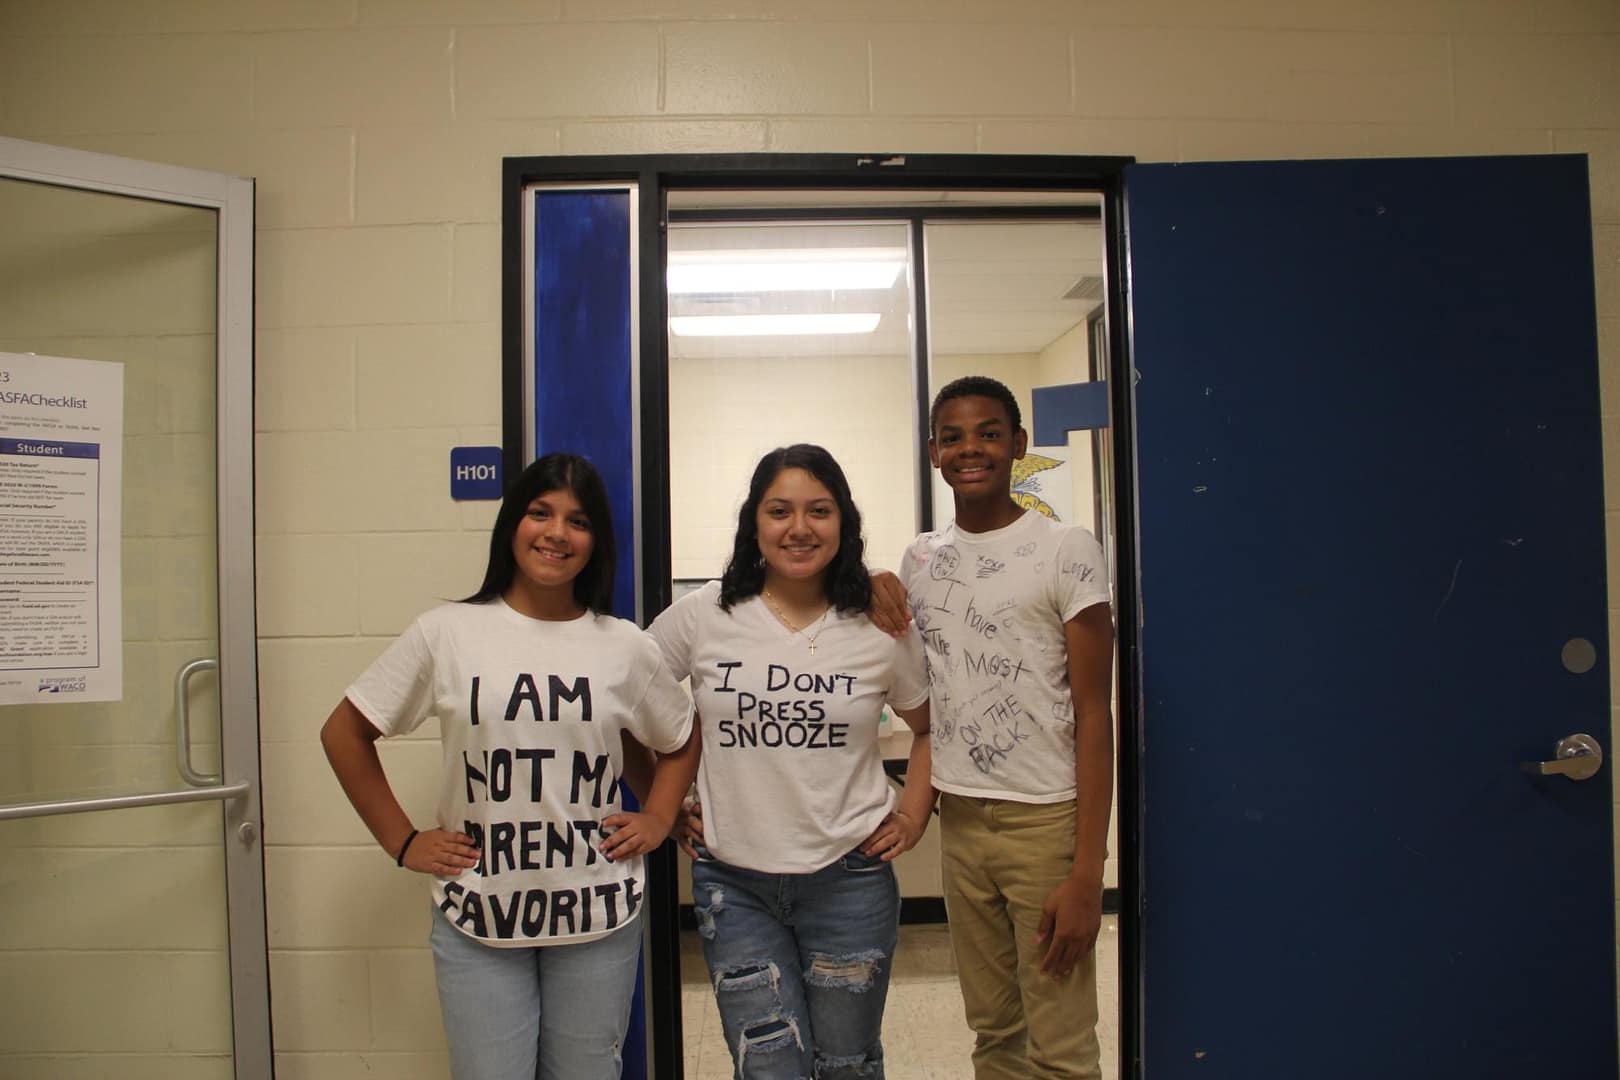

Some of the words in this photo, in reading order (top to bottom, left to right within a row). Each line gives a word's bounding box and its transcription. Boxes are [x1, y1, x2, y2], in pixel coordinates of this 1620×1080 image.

[0, 371, 10, 383] 3
[16, 442, 64, 455] Student
[456, 465, 496, 481] H101
[964, 595, 998, 640] have
[714, 661, 742, 692] I
[469, 676, 480, 726] I
[503, 673, 593, 722] AM
[982, 694, 1023, 727] THE
[719, 720, 849, 748] SNOOZE
[968, 720, 1030, 775] BACK
[463, 748, 555, 804] NOT
[463, 819, 617, 878] RENT
